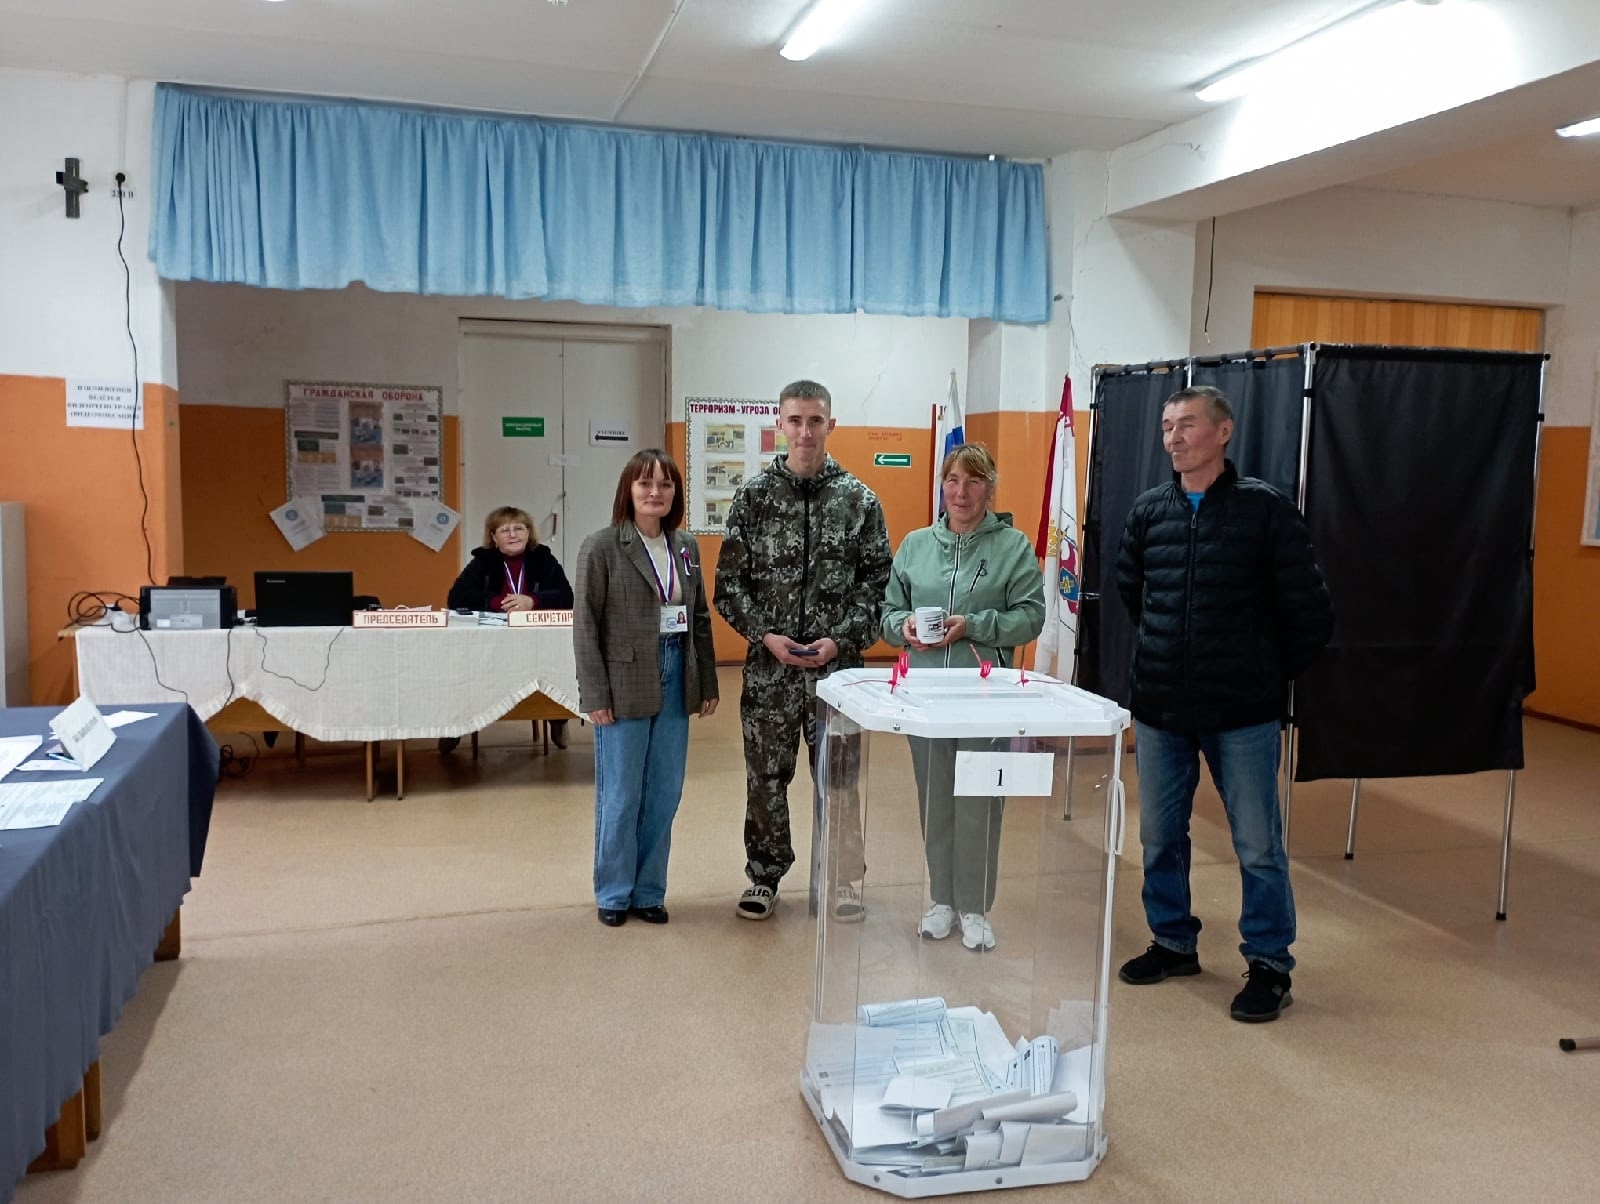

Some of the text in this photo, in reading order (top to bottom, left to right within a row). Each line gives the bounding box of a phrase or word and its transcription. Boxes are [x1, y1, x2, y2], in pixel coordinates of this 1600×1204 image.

[303, 388, 424, 401] ГРАЖДАНСКАЯ ОБОРОНА
[689, 403, 736, 414] ТЕРРОРИЗМ
[741, 405, 770, 415] УГРОЗА
[772, 406, 781, 416] О
[363, 614, 439, 625] ПРЕДСЕДАТЕЛЬ
[526, 612, 574, 623] СЕКРЕТАР
[996, 767, 1004, 787] 1
